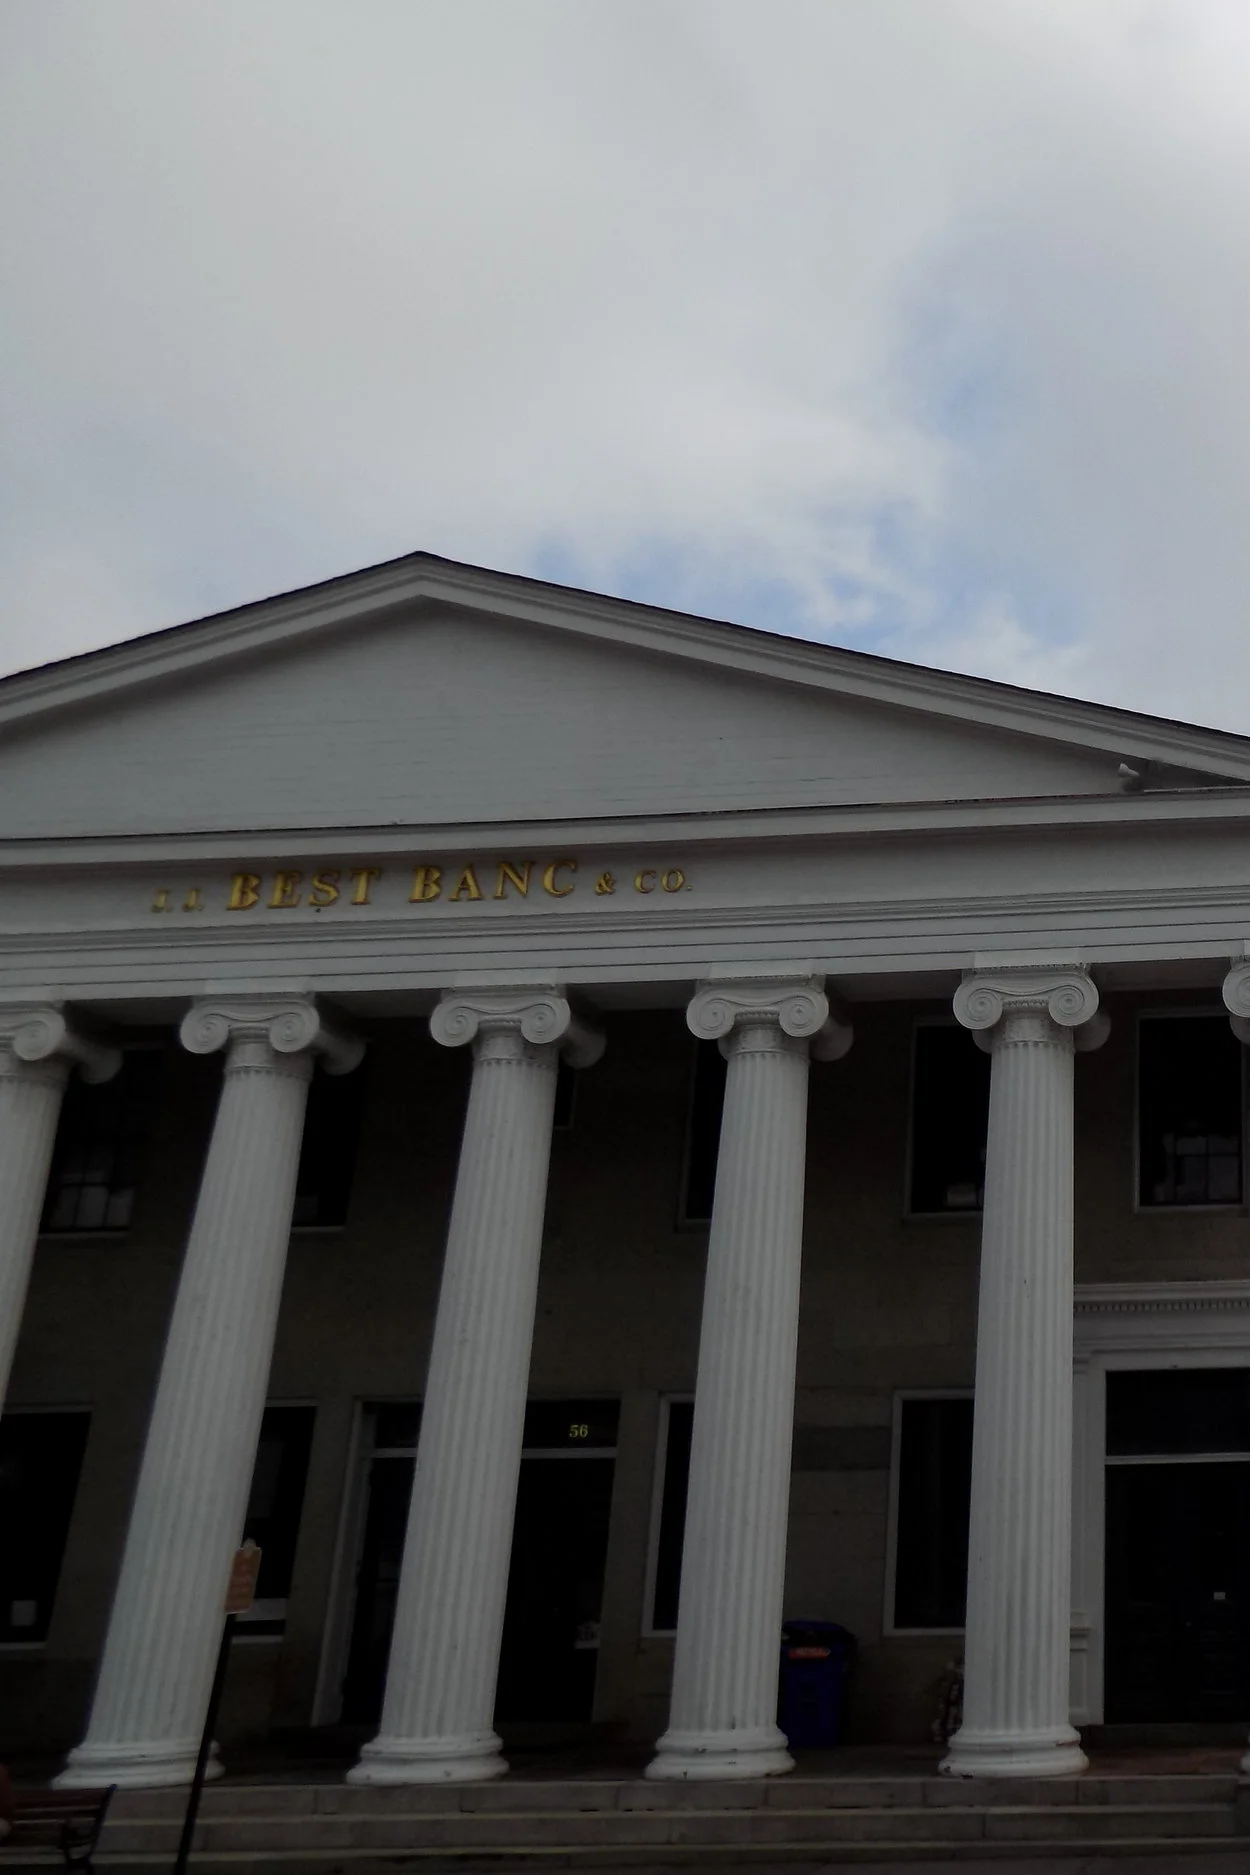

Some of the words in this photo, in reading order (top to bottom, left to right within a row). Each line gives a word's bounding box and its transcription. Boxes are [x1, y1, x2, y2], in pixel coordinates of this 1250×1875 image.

[226, 868, 381, 910] BEST
[408, 858, 578, 902] BANC
[594, 871, 616, 896] &
[634, 867, 693, 894] CO.
[569, 1423, 589, 1438] 56
